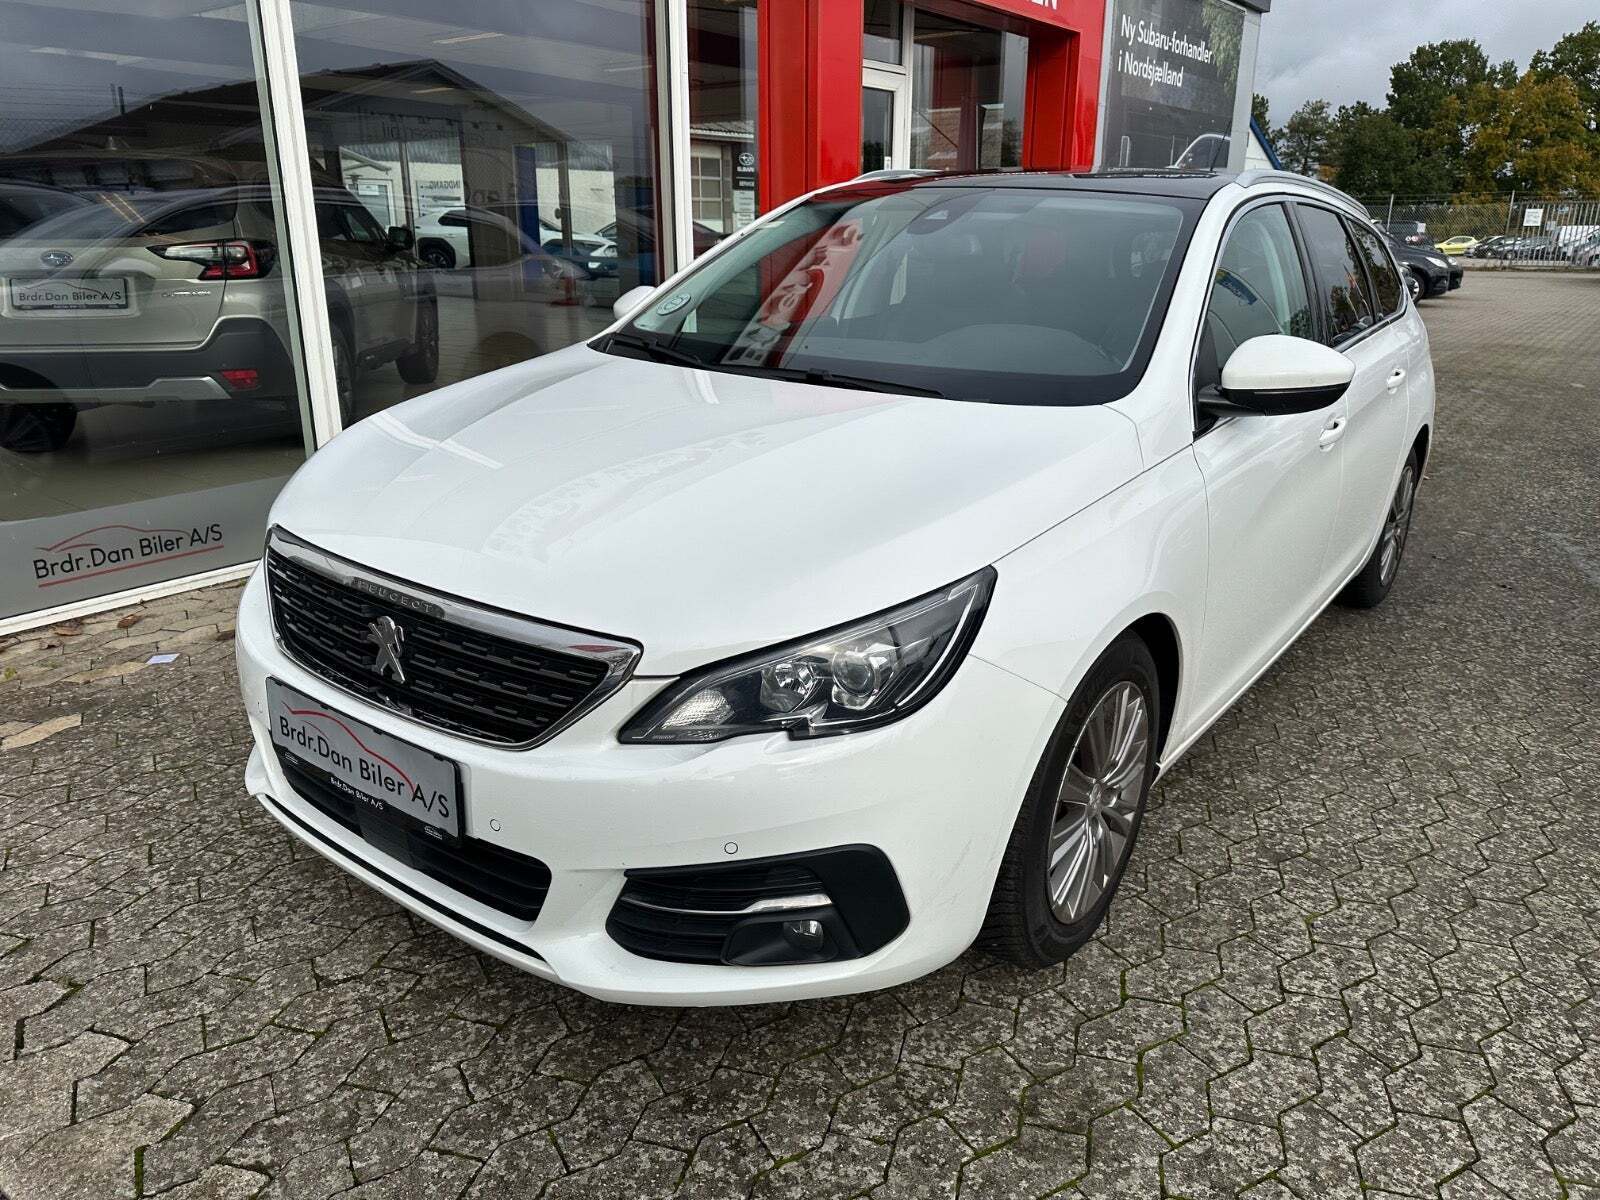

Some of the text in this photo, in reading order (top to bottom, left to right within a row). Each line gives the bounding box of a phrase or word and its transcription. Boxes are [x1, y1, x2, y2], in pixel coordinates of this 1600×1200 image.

[1121, 14, 1213, 64] Ny Subaru-forhandler
[1118, 50, 1184, 87] i Nordsjælland
[72, 291, 98, 301] Biler
[101, 291, 122, 300] A/S
[33, 524, 223, 579] Brdr.Dan Biler A/S
[279, 715, 450, 818] Brdr.Dan Biler A/S
[370, 798, 384, 810] A/S
